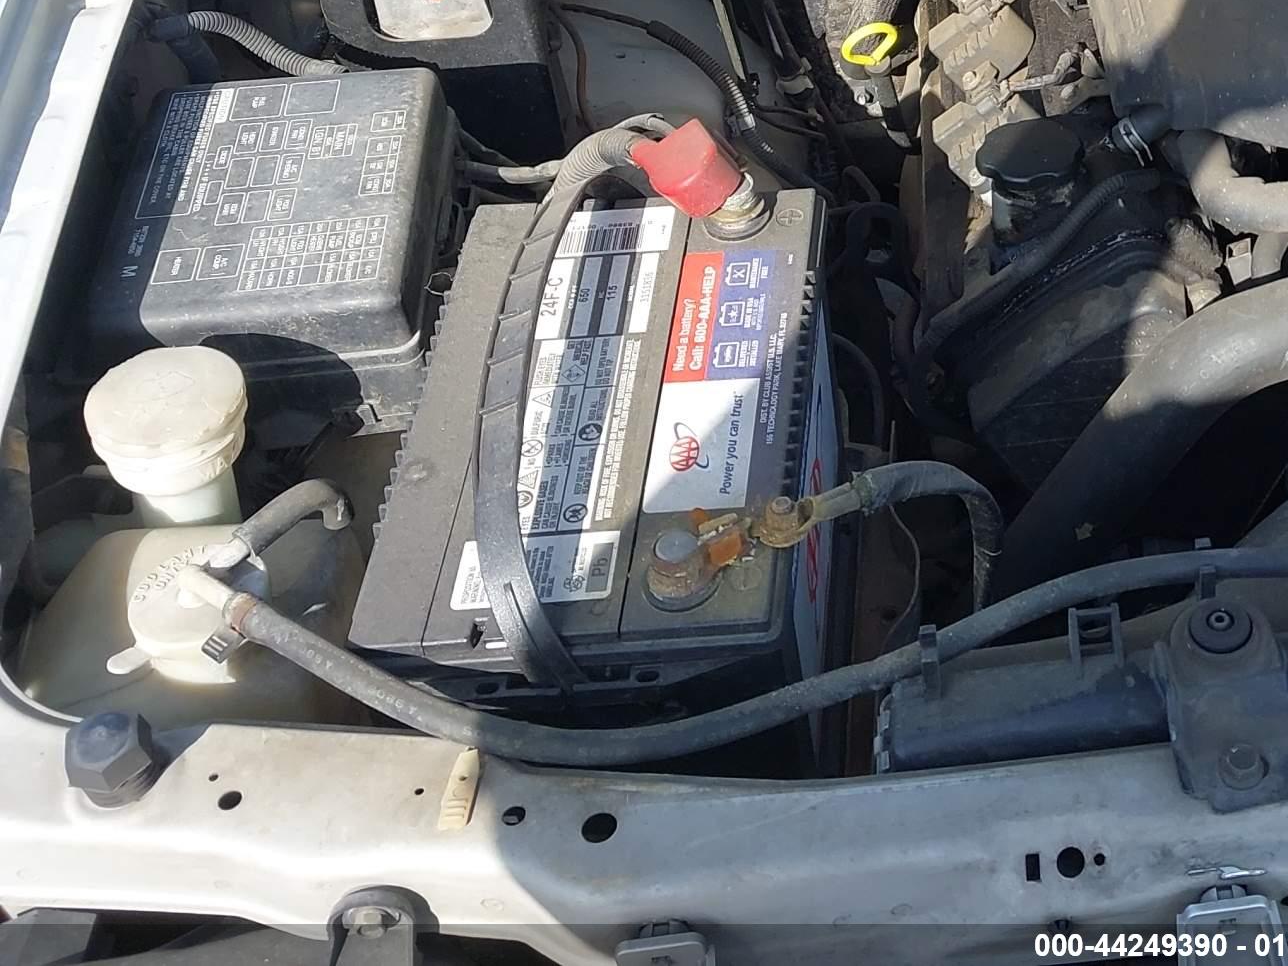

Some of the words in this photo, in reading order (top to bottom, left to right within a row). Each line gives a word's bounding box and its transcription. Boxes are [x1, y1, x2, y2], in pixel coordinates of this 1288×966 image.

[312, 129, 324, 145] IGN.
[333, 131, 344, 149] MAIN
[119, 265, 138, 277] M
[169, 257, 181, 275] HEATER
[539, 275, 564, 316] 24F-C
[578, 287, 590, 302] 650
[606, 284, 618, 300] 115
[695, 265, 716, 342] 800-AAA-HELP
[673, 345, 686, 371] Need
[680, 298, 694, 334] battery?
[689, 344, 704, 370] Call:
[731, 394, 743, 416] trust
[729, 419, 739, 437] can
[726, 439, 740, 459] you
[720, 461, 734, 494] Power
[590, 557, 608, 576] Pb
